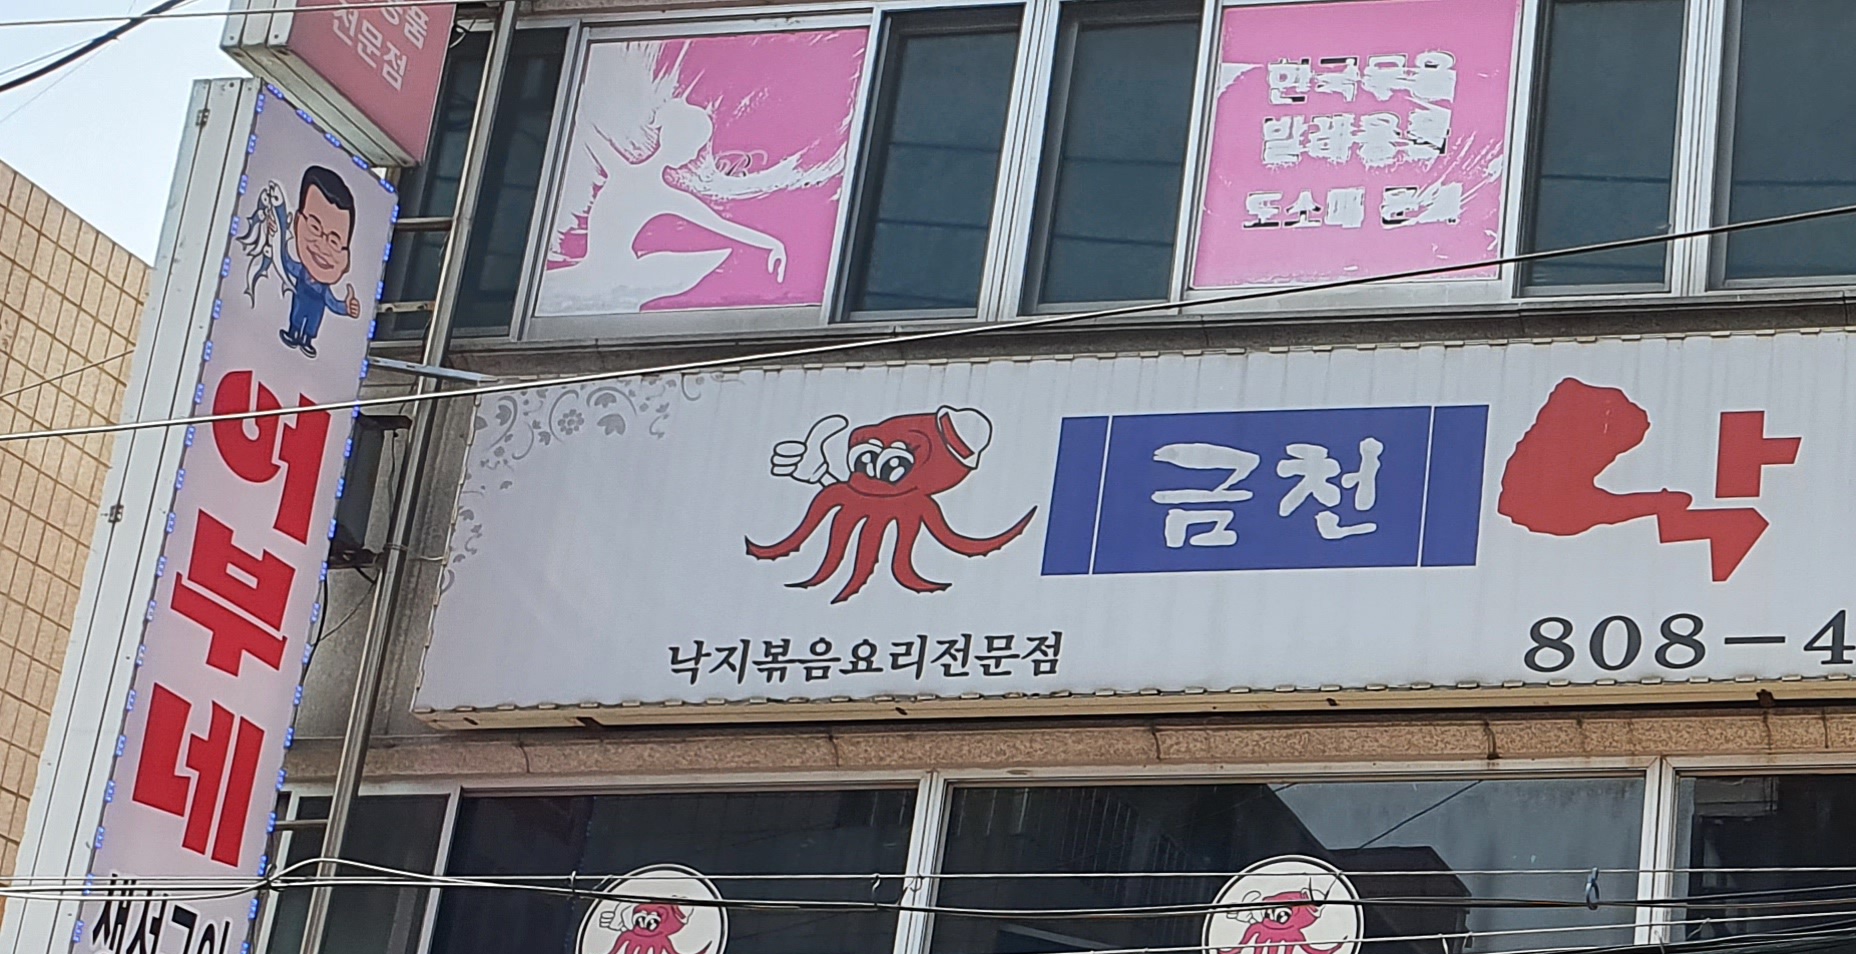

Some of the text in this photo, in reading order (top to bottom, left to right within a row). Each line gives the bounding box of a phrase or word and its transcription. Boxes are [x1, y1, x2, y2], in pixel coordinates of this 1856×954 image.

[1152, 437, 1386, 549] 금천
[132, 370, 331, 868] 어부네
[668, 631, 1064, 686] 낙지볶음요리전문점
